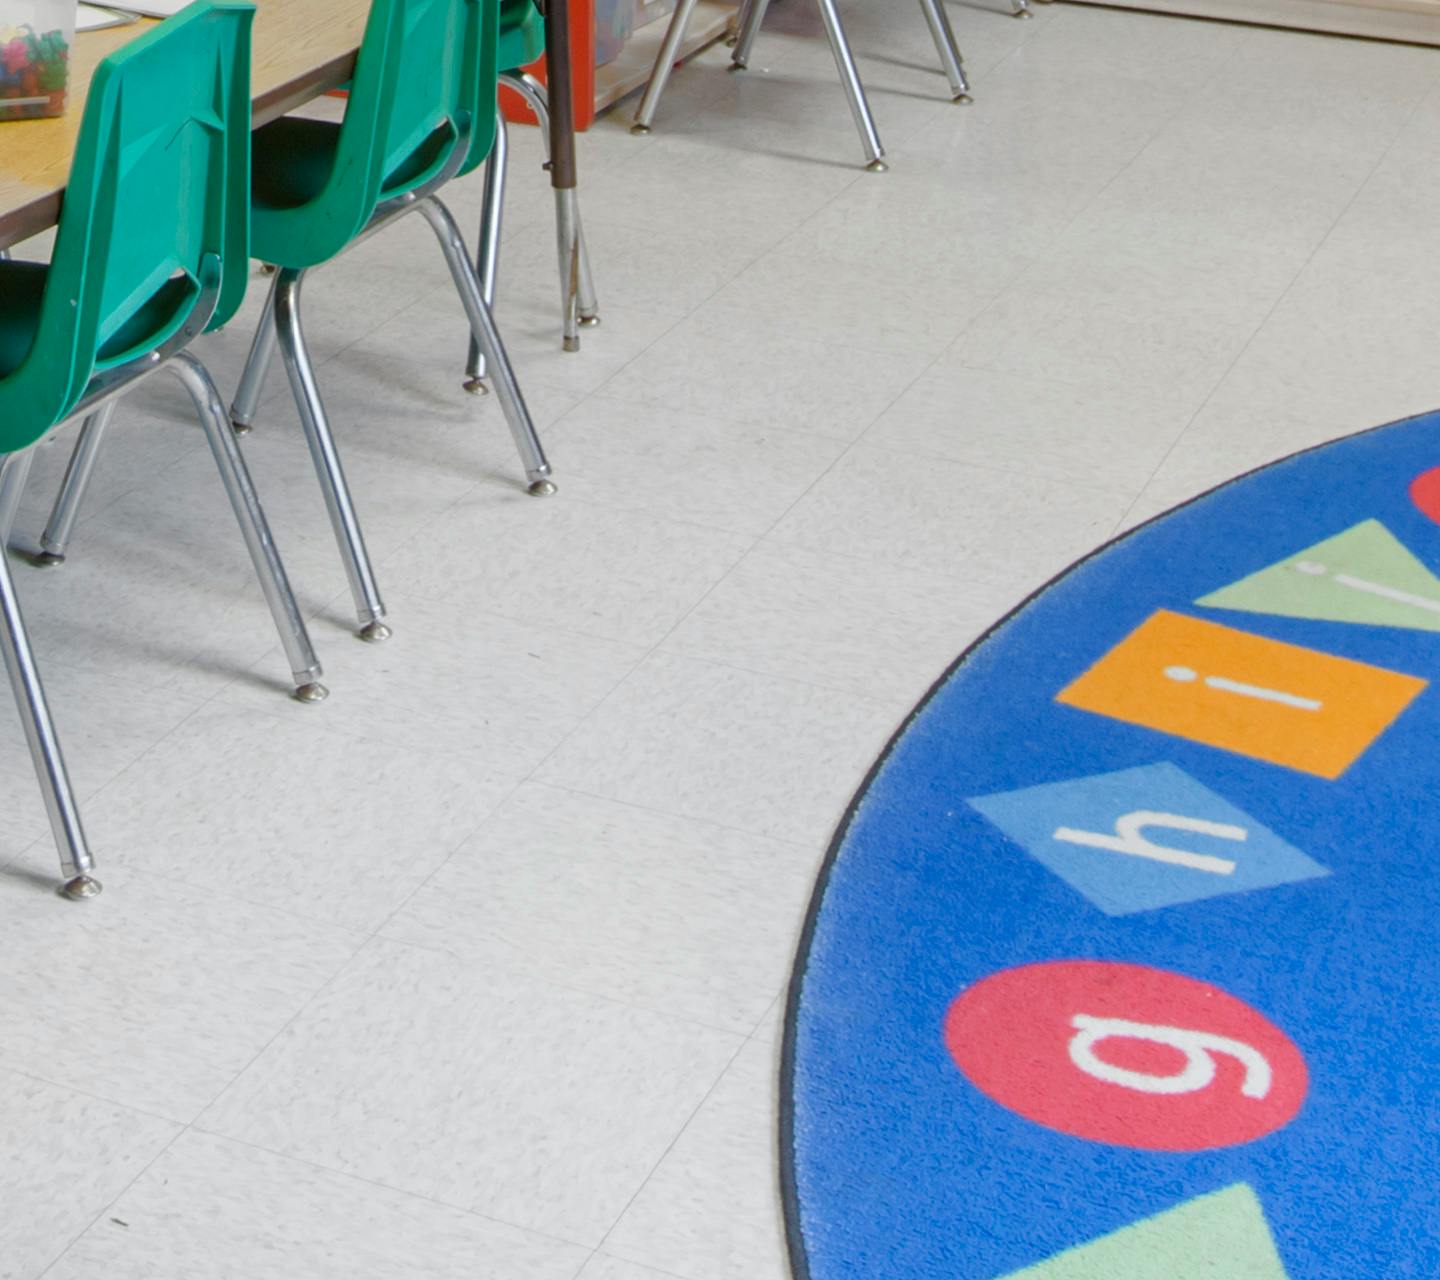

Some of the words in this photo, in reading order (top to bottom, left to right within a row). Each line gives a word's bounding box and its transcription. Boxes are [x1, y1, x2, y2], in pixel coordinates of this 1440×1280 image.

[1163, 663, 1322, 710] i
[1052, 808, 1248, 876] h
[1068, 1012, 1271, 1099] g
